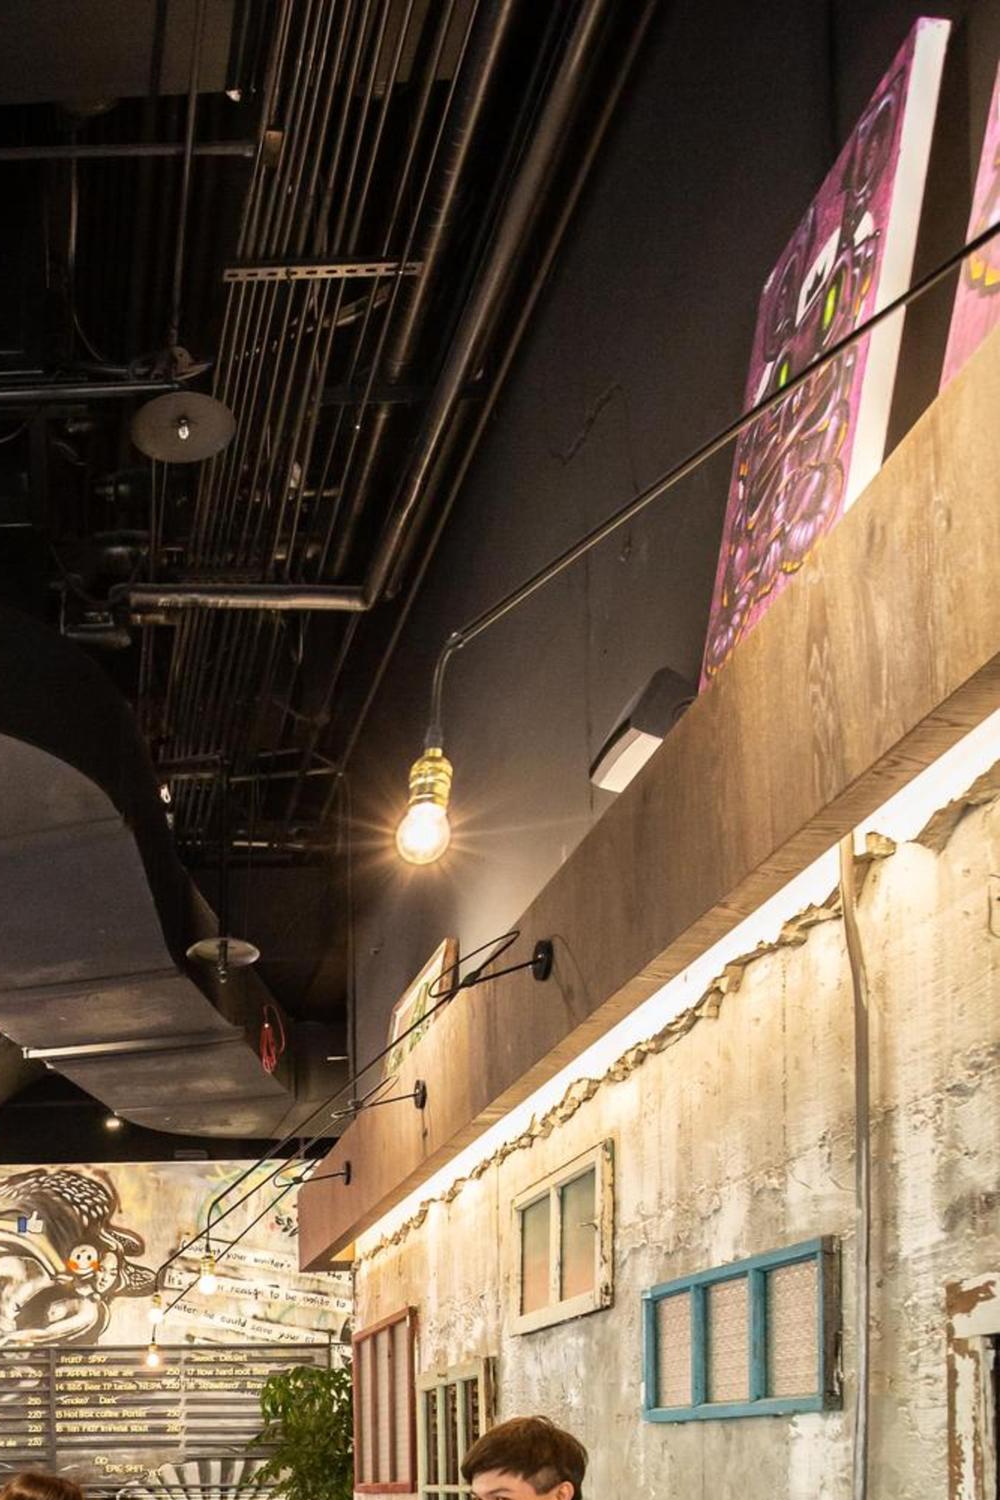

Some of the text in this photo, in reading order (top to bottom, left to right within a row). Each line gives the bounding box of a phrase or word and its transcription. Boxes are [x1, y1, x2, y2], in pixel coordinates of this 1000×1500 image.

[270, 1289, 280, 1300] to
[336, 1299, 347, 1309] to
[27, 1410, 42, 1419] 220
[28, 1423, 42, 1433] 220
[28, 1437, 42, 1447] 220
